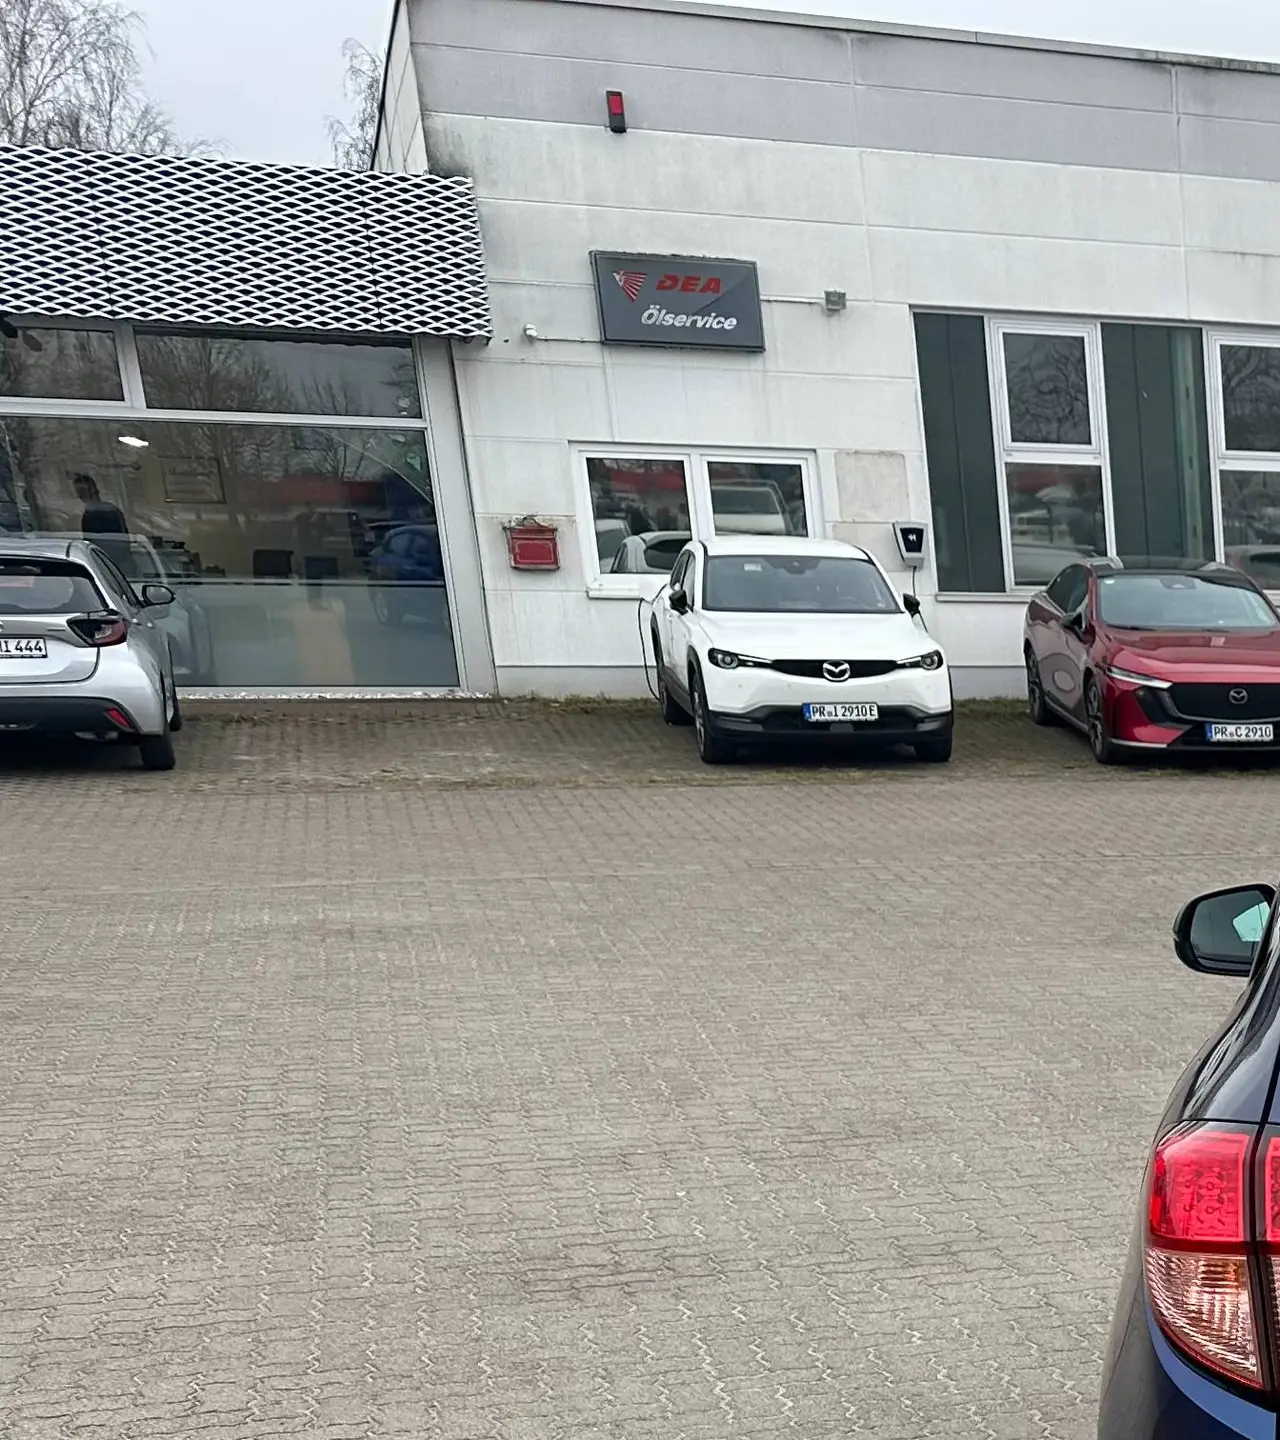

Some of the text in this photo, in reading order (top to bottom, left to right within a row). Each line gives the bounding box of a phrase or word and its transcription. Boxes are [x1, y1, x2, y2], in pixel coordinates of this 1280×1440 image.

[655, 273, 722, 294] DEA
[641, 304, 738, 330] Ölservice
[15, 640, 43, 653] 444
[811, 705, 826, 717] PR
[1213, 726, 1228, 738] PR
[1244, 726, 1272, 738] 2910
